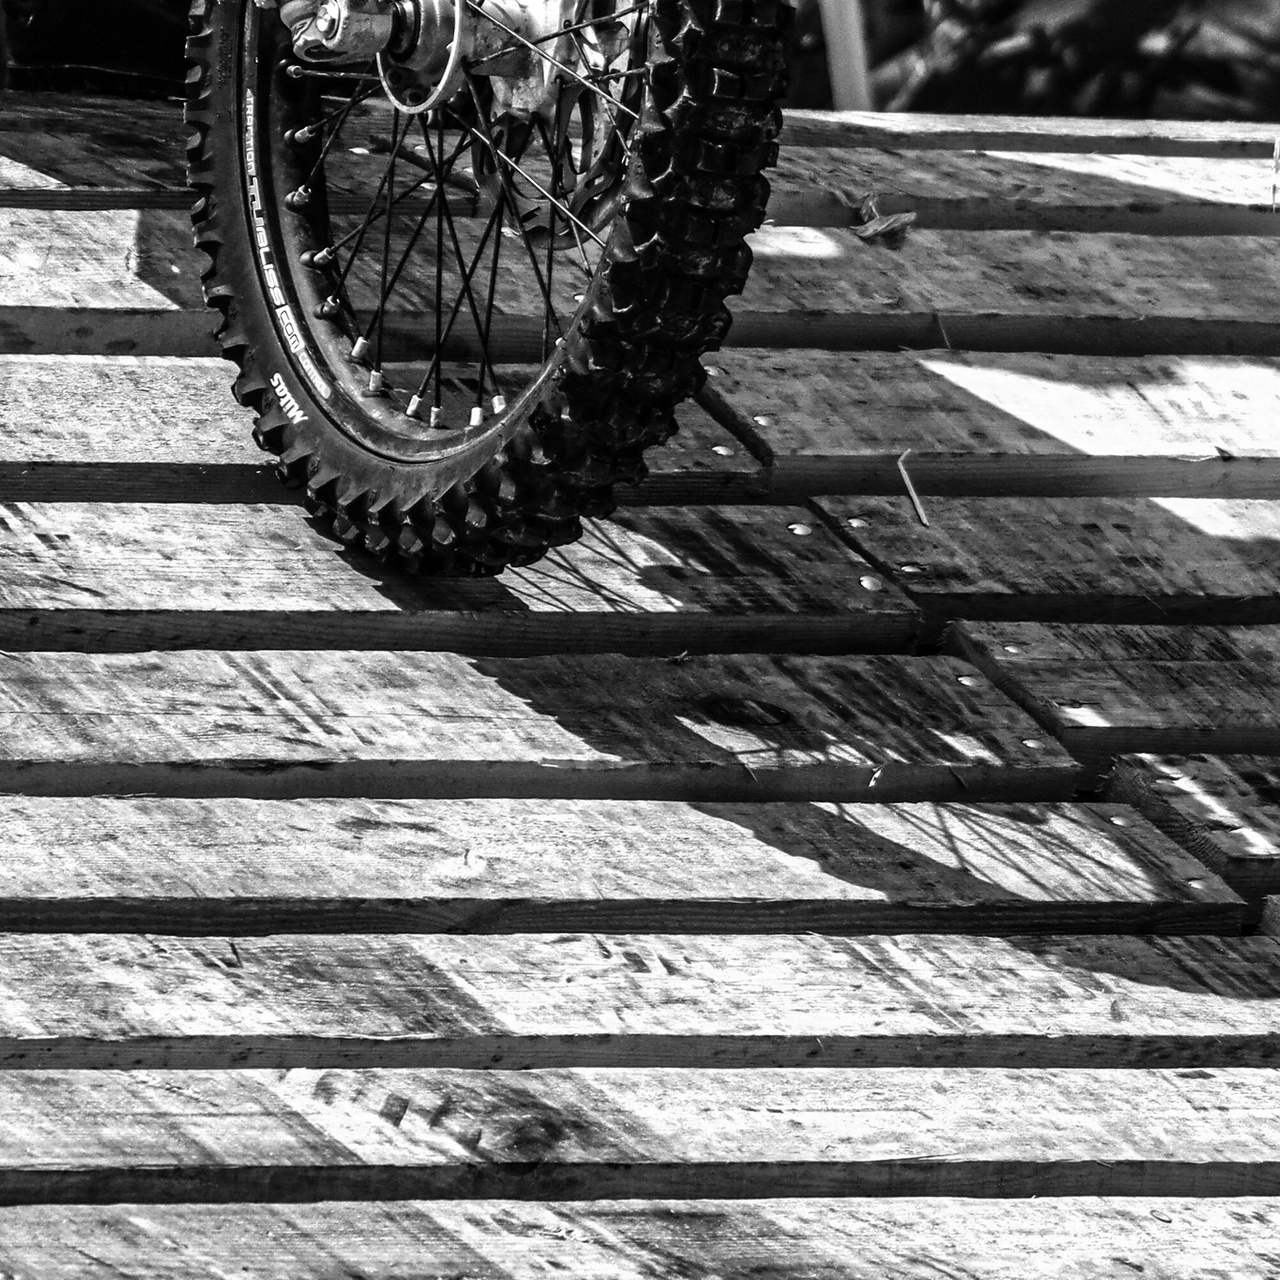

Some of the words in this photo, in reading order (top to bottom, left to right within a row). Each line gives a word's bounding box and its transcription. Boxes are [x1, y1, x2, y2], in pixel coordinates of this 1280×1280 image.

[245, 95, 256, 175] TRACTION
[298, 351, 329, 397] CONTROL
[270, 372, 309, 425] Mitas
